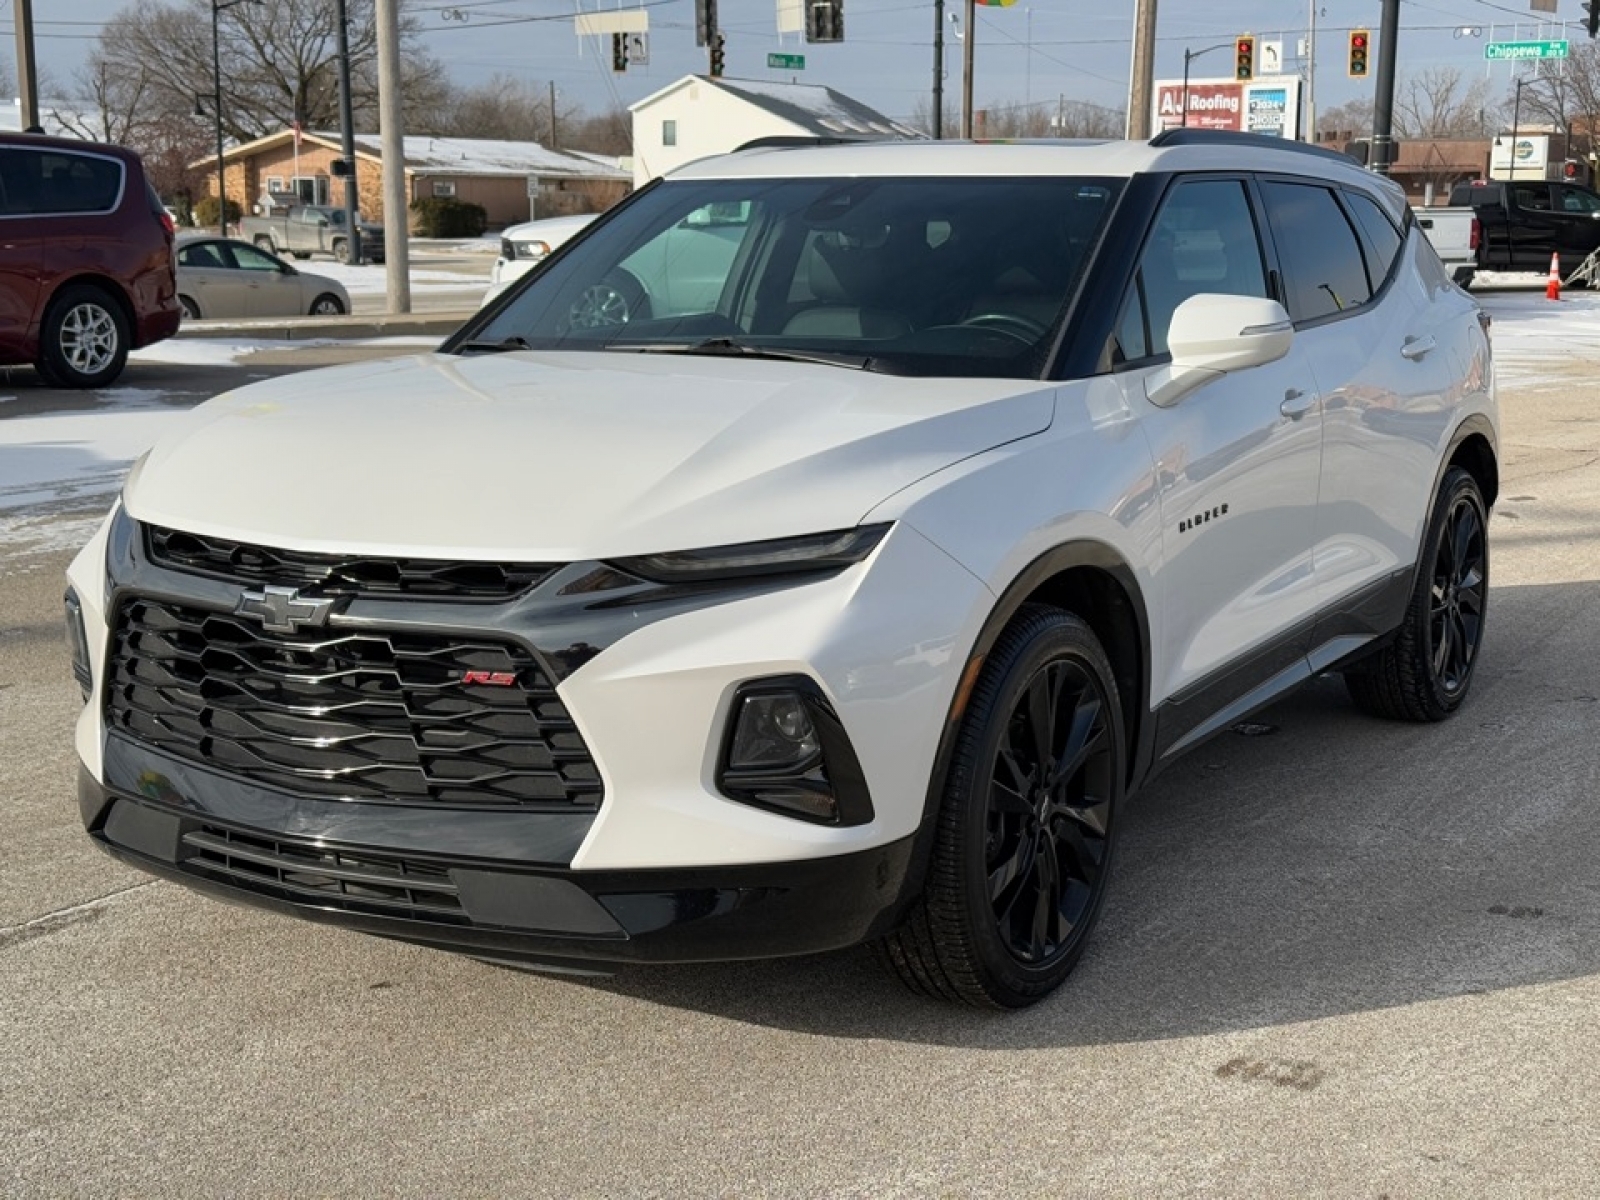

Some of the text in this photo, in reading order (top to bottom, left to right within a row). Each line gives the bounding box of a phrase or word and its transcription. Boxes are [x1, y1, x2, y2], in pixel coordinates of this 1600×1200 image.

[1487, 44, 1542, 59] Chippewa
[1161, 91, 1239, 114] AJ Roofing
[1248, 114, 1286, 125] CHOICE
[1179, 503, 1229, 534] BLAZER
[462, 671, 516, 686] RS
